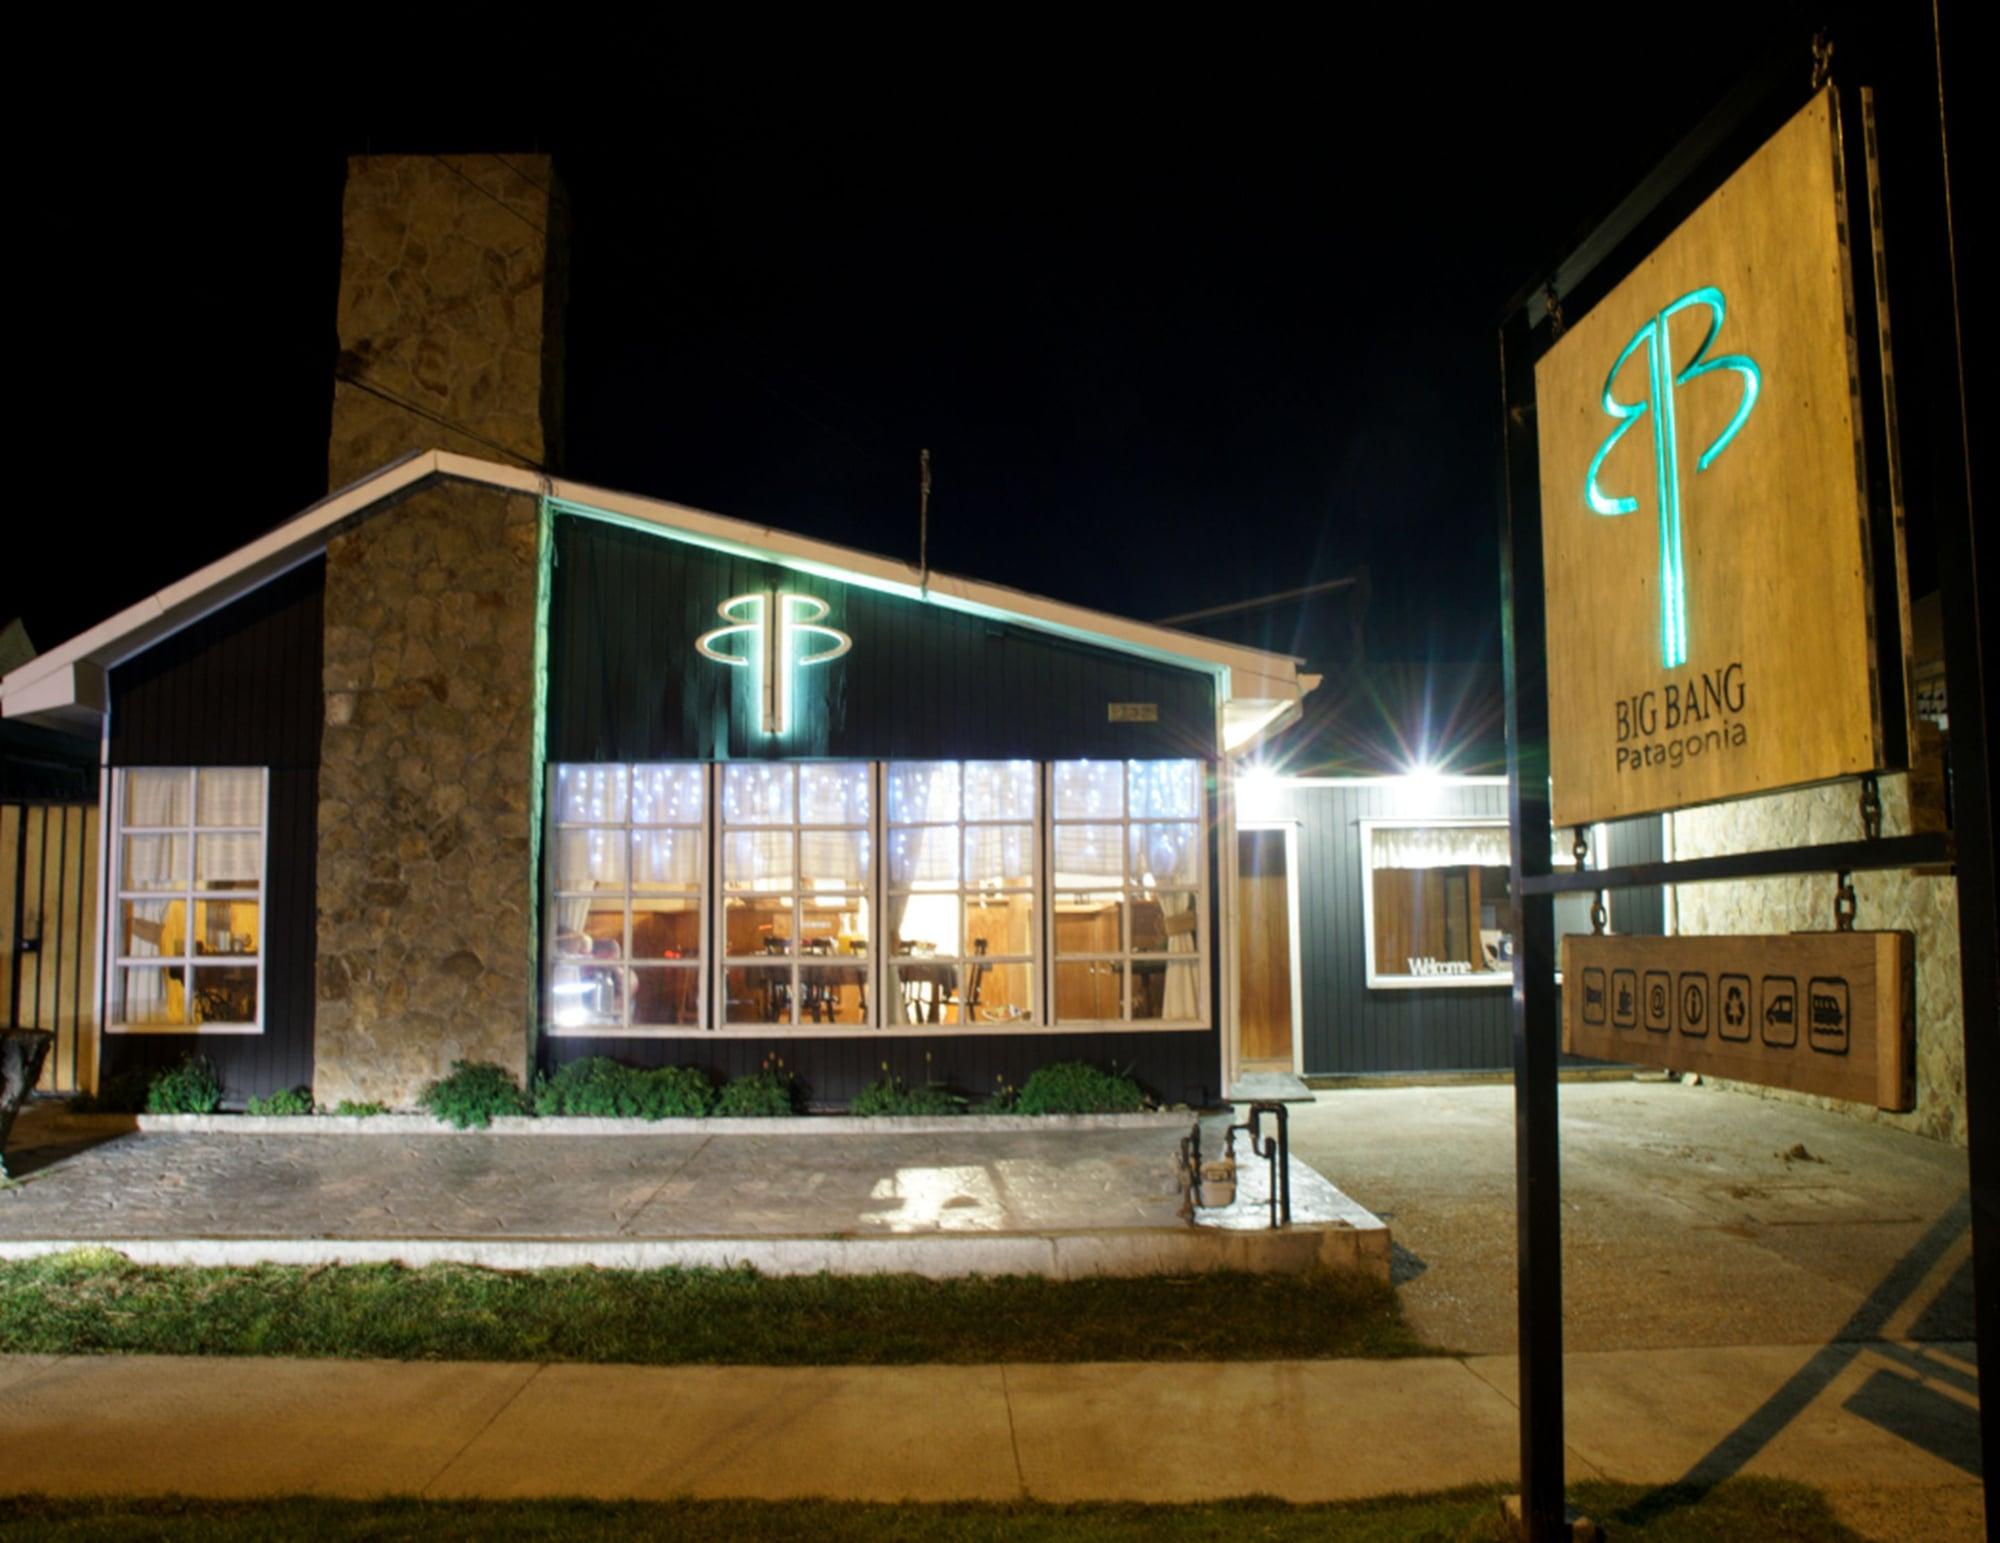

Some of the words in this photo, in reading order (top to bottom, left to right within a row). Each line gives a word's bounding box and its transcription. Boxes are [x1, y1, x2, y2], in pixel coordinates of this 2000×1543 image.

[1615, 691, 1658, 743] BIG
[1664, 662, 1746, 730] BANG
[1616, 719, 1748, 773] Patagonia
